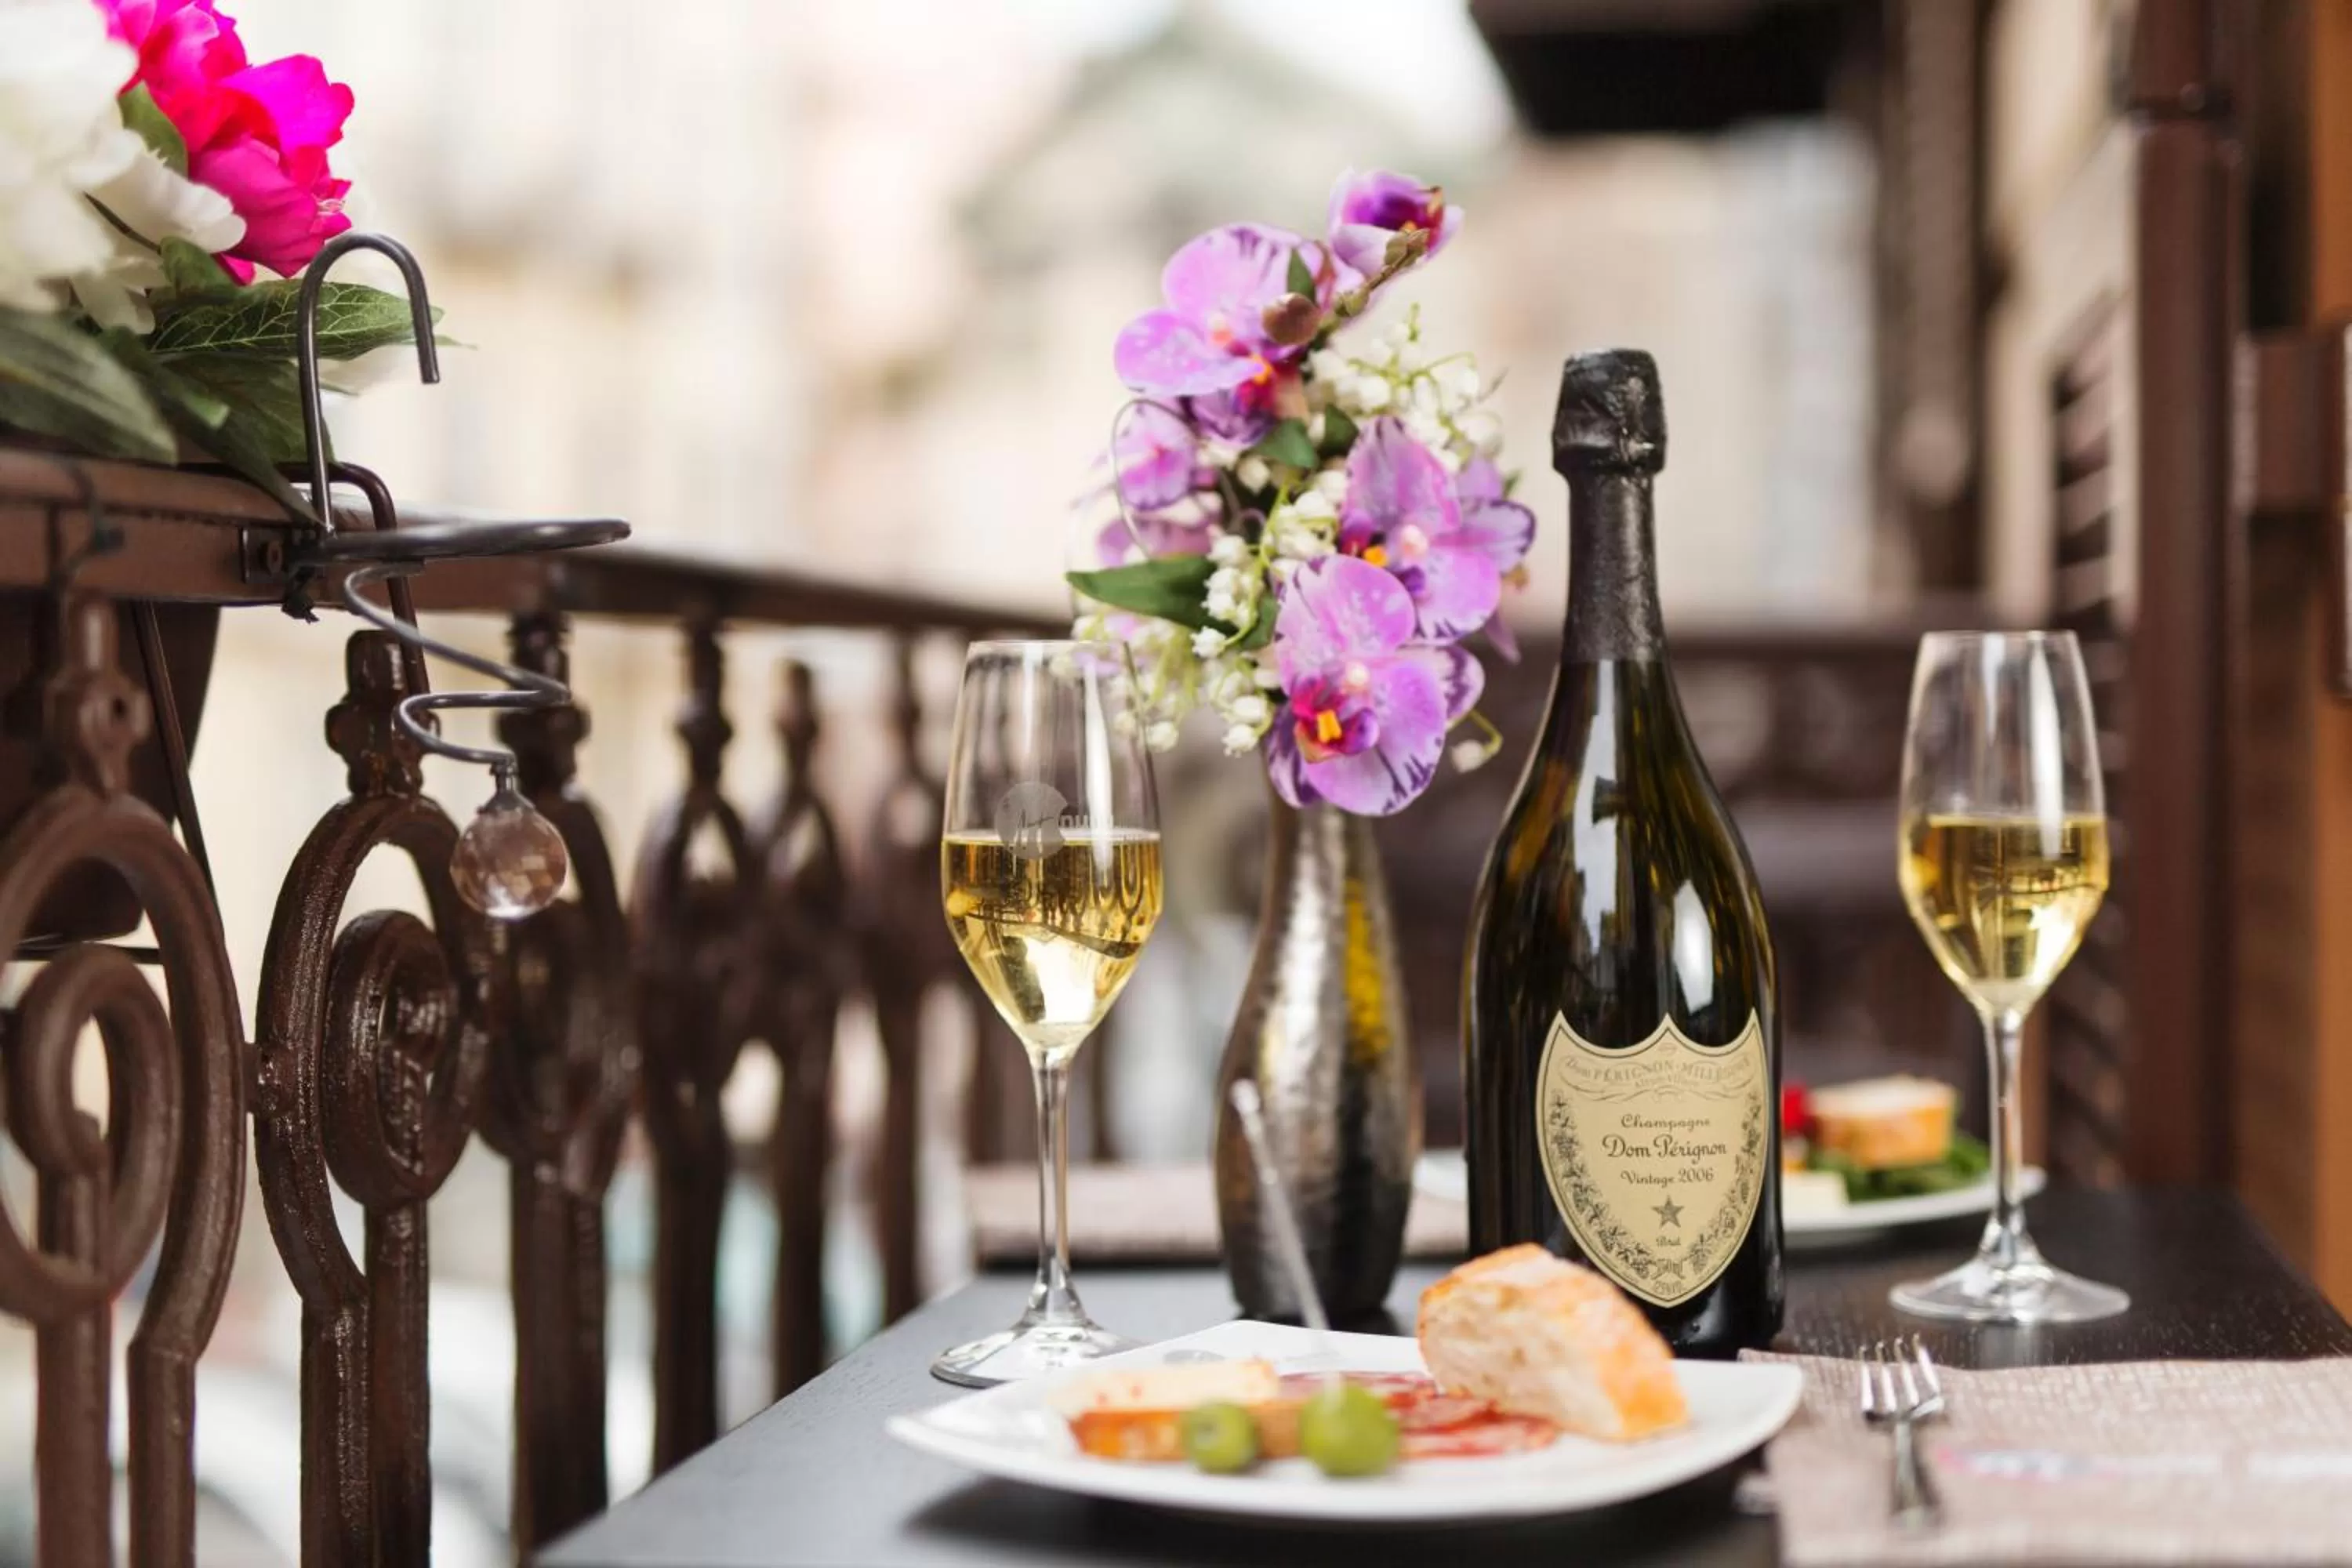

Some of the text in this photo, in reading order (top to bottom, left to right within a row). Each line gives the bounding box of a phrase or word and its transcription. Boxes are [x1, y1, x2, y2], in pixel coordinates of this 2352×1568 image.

[1621, 1113, 1711, 1133] Champagne
[1601, 1133, 1727, 1165] Dom Pérignon
[1620, 1167, 1715, 1189] Vintage 2006
